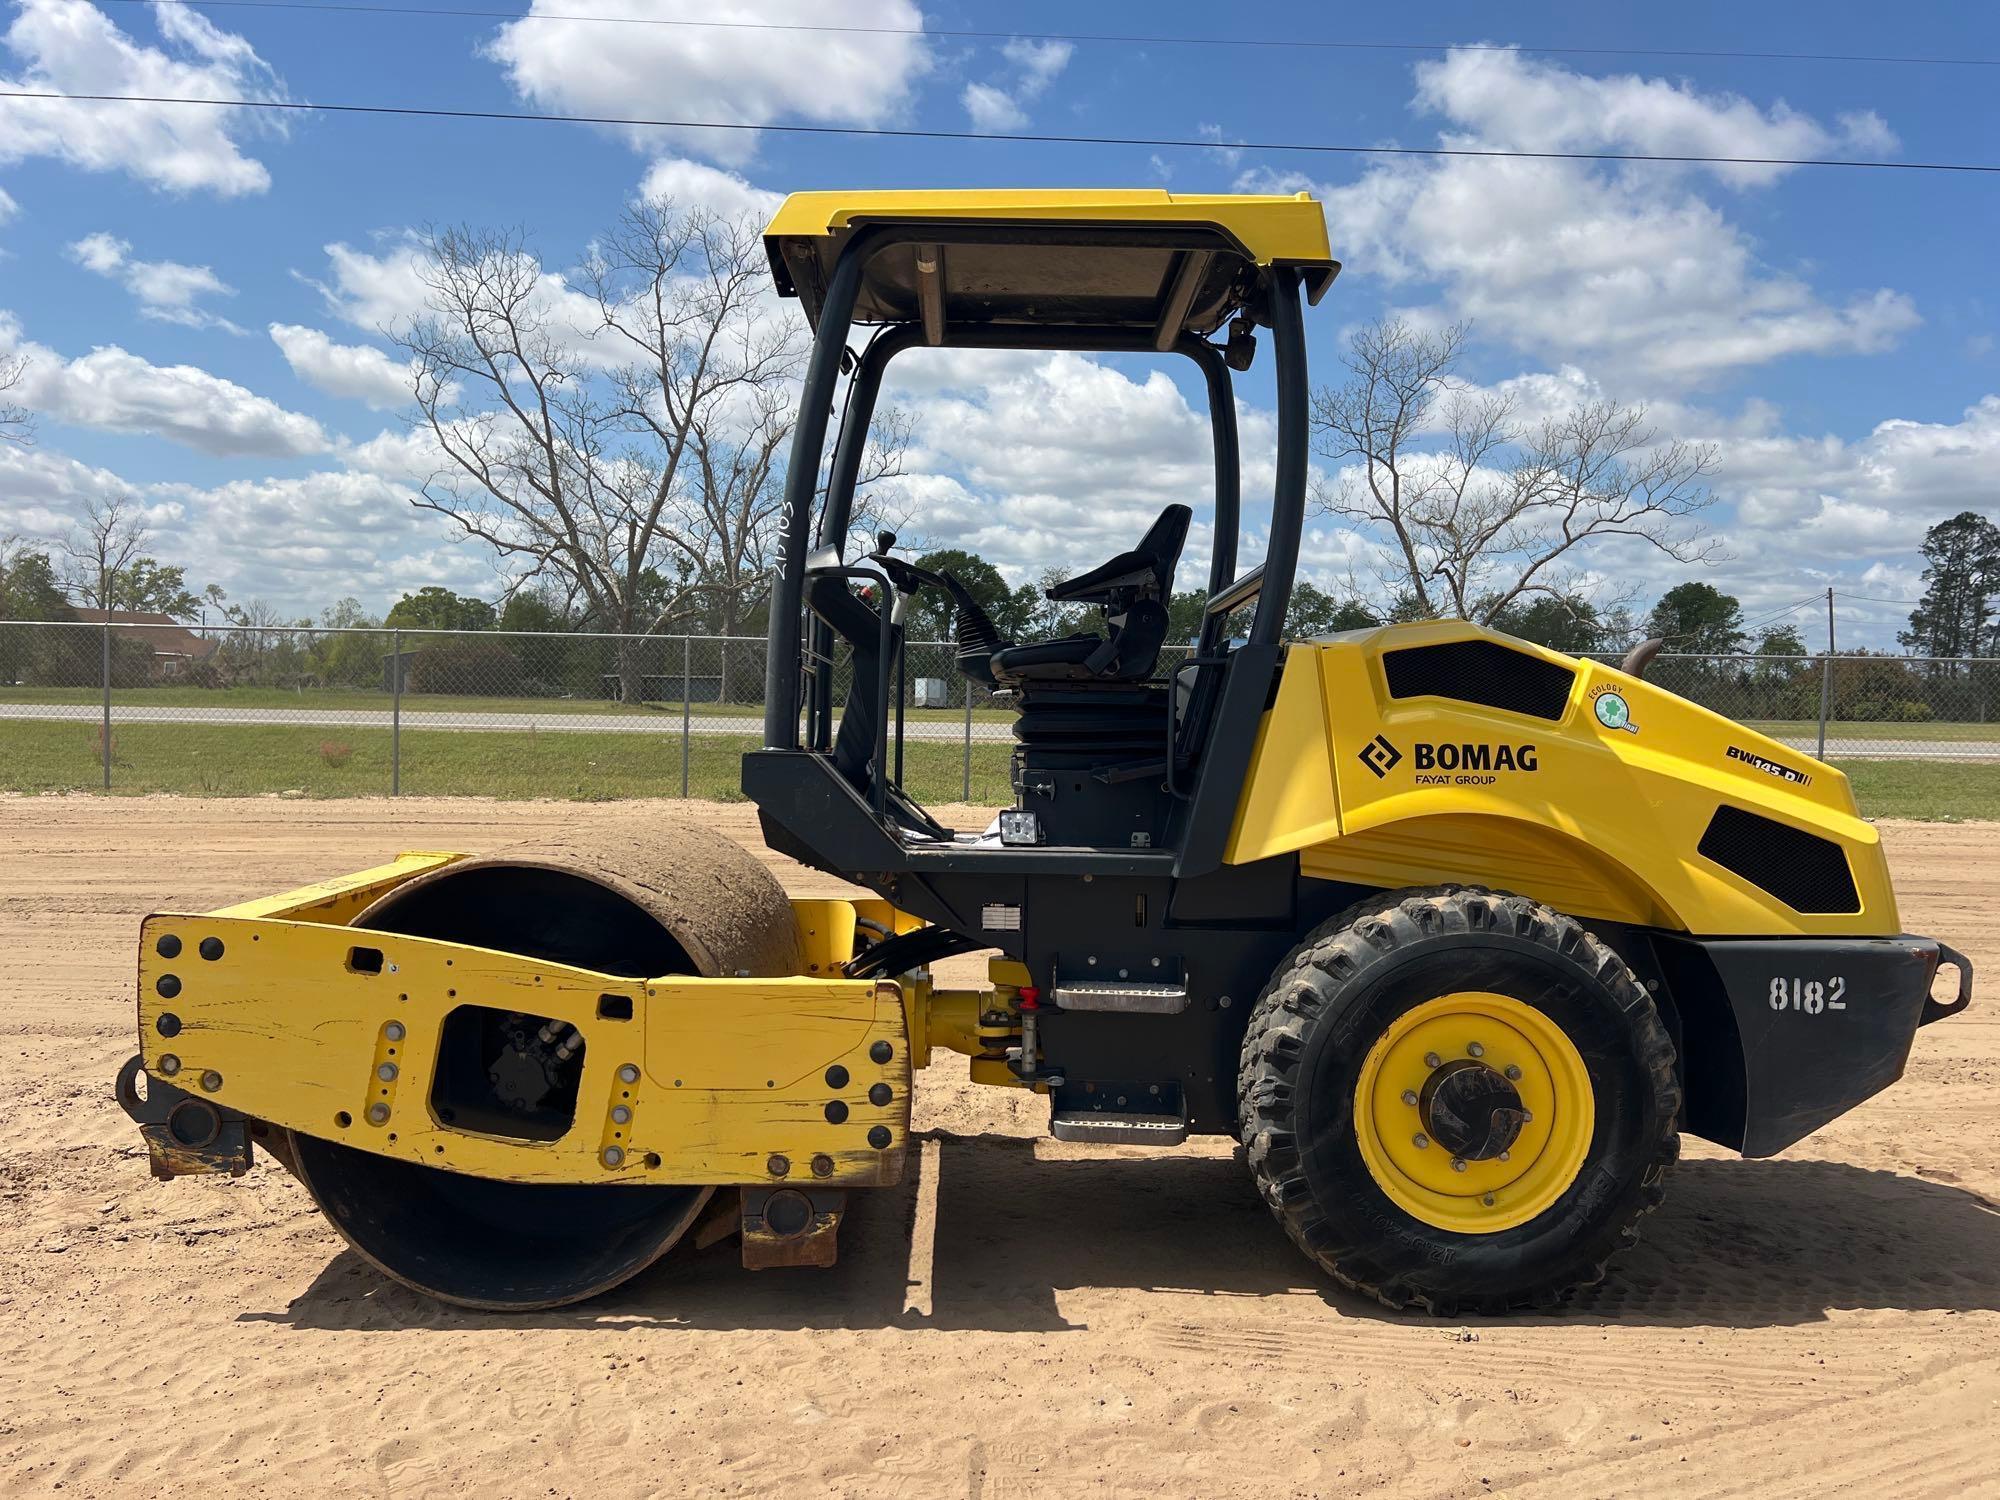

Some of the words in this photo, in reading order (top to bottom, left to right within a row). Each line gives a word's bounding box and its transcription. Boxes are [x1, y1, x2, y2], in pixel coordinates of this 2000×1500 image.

[1588, 684, 1623, 700] ECOLOGY
[1415, 743, 1538, 772] BOMAG
[1415, 775, 1451, 785] FAYAT
[1455, 775, 1496, 785] GROUP
[1768, 976, 1847, 1015] 8182
